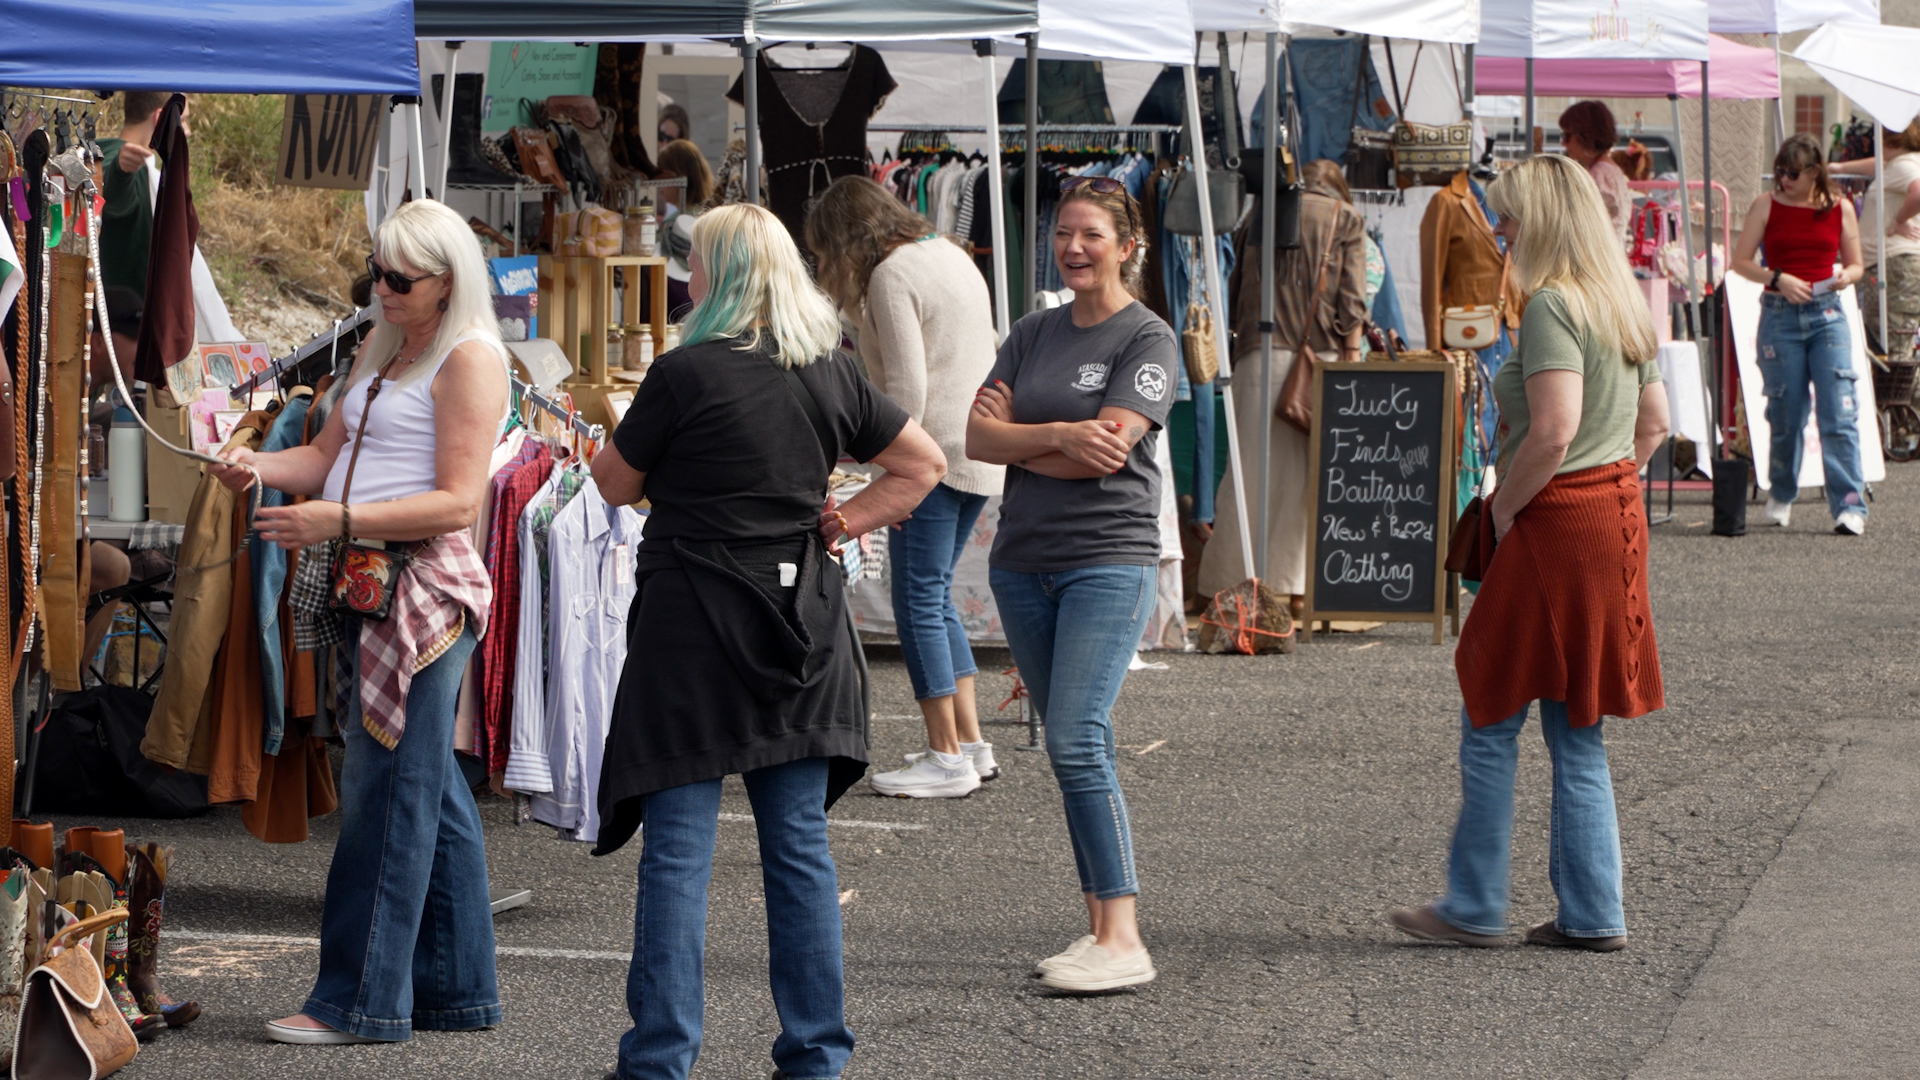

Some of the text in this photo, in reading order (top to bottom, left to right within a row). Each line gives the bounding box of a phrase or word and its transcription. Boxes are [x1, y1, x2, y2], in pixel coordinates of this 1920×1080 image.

[1335, 380, 1418, 431] Lucky
[1330, 427, 1401, 463] Finds
[1326, 467, 1432, 518] Boutique
[1322, 514, 1366, 541] New
[1371, 515, 1381, 539] &
[1324, 549, 1414, 602] Clothing
